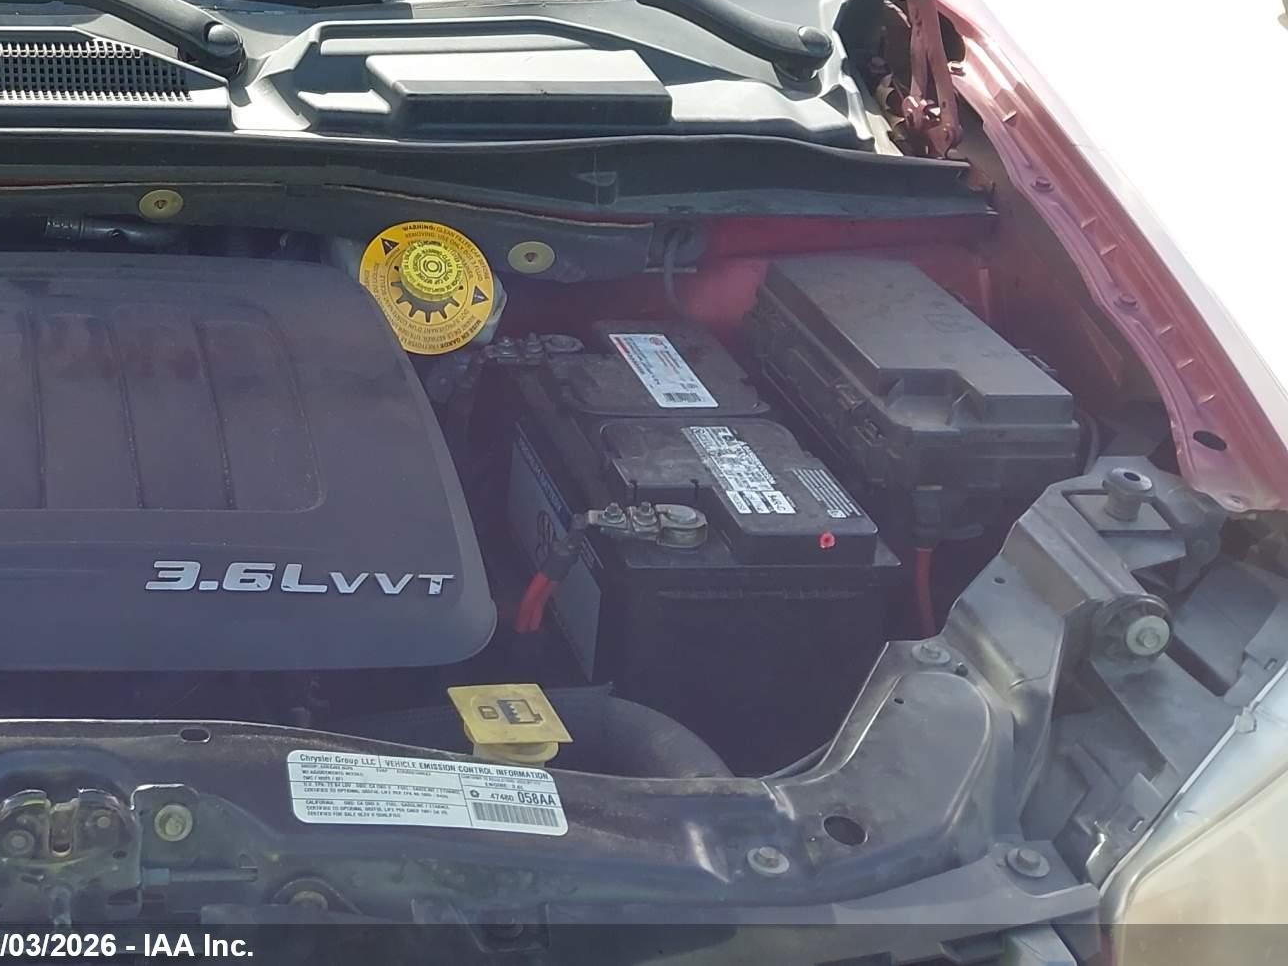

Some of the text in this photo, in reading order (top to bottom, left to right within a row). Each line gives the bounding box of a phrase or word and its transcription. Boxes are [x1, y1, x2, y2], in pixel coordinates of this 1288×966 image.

[299, 753, 376, 766] Chrysler Group LLC
[385, 759, 416, 769] VEHICLE
[419, 761, 456, 771] EMISSION
[458, 765, 494, 775] CONTROL
[496, 768, 549, 780] INFORMATION
[517, 791, 556, 806] 058AA
